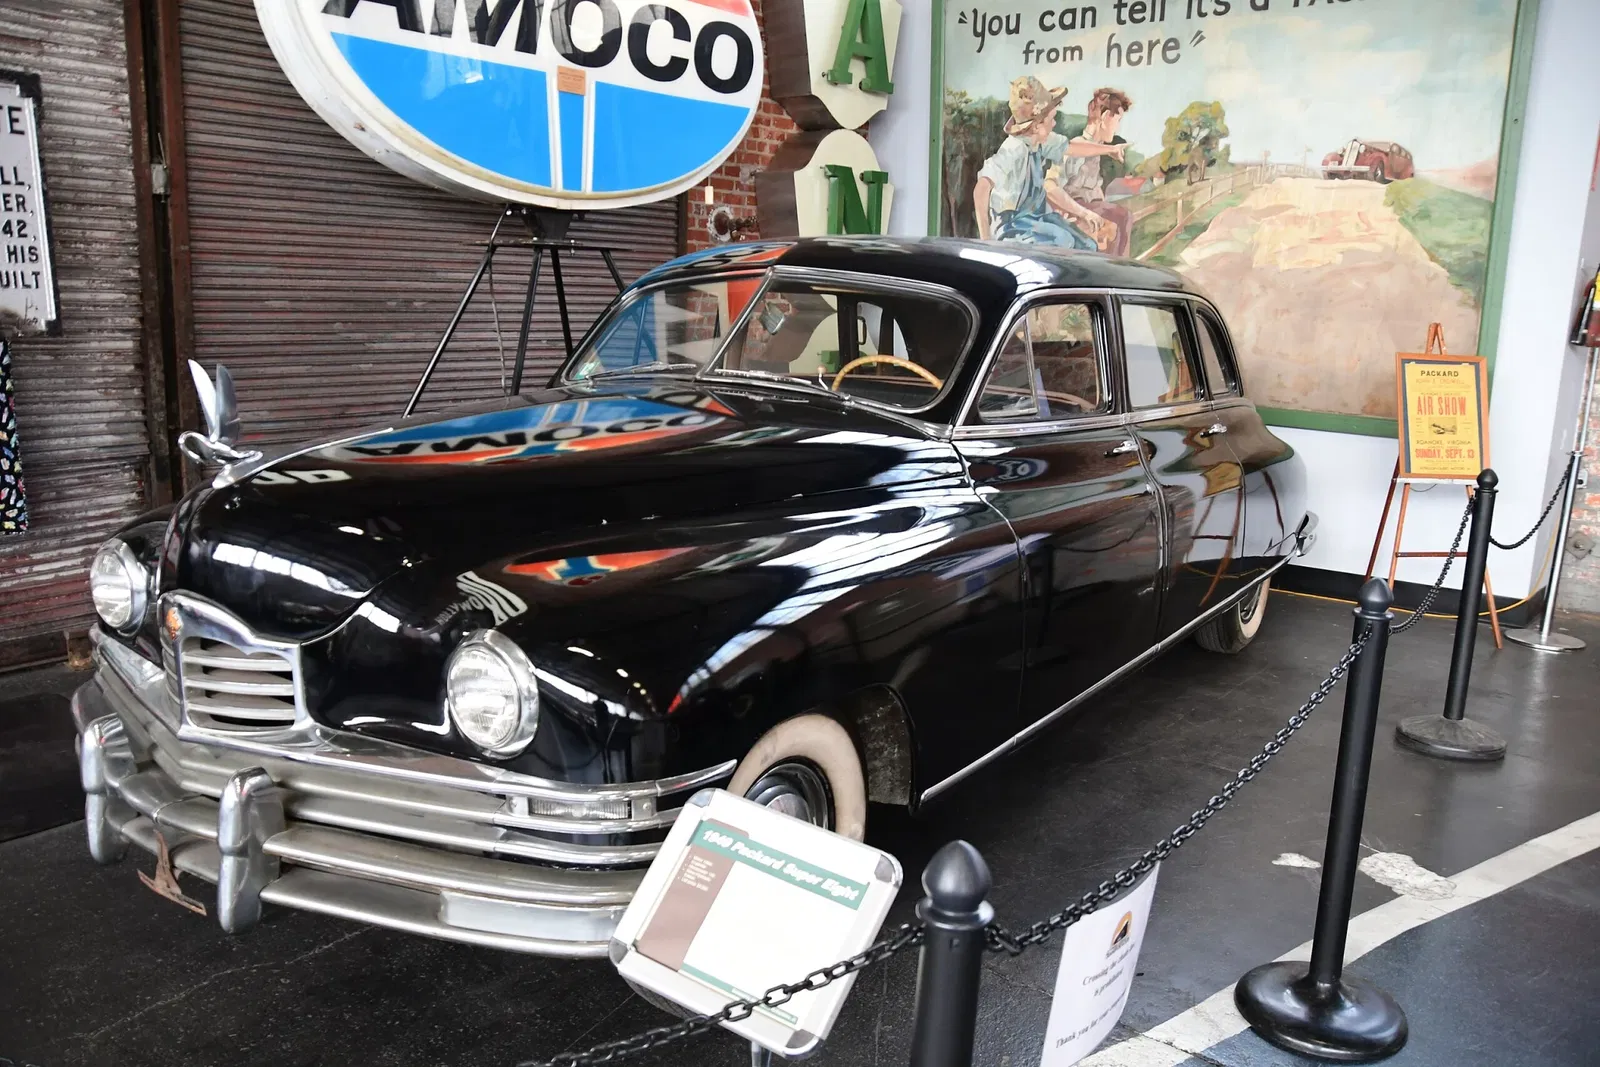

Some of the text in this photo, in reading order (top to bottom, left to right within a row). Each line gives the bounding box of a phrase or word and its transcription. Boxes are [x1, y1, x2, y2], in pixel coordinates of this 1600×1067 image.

[1038, 6, 1097, 32] can
[1113, 0, 1166, 25] tell
[1186, 0, 1231, 19] its
[1022, 40, 1083, 65] from
[0, 104, 25, 135] E
[2, 219, 36, 241] 42,
[7, 245, 38, 263] HIS
[1417, 396, 1466, 416] AIR SHOW
[1415, 448, 1444, 459] SUNDAY,
[1445, 449, 1466, 459] SEPT.
[731, 841, 785, 870] Packard
[783, 860, 826, 887] Super
[820, 876, 859, 901] Eight
[1056, 1032, 1076, 1049] Thank
